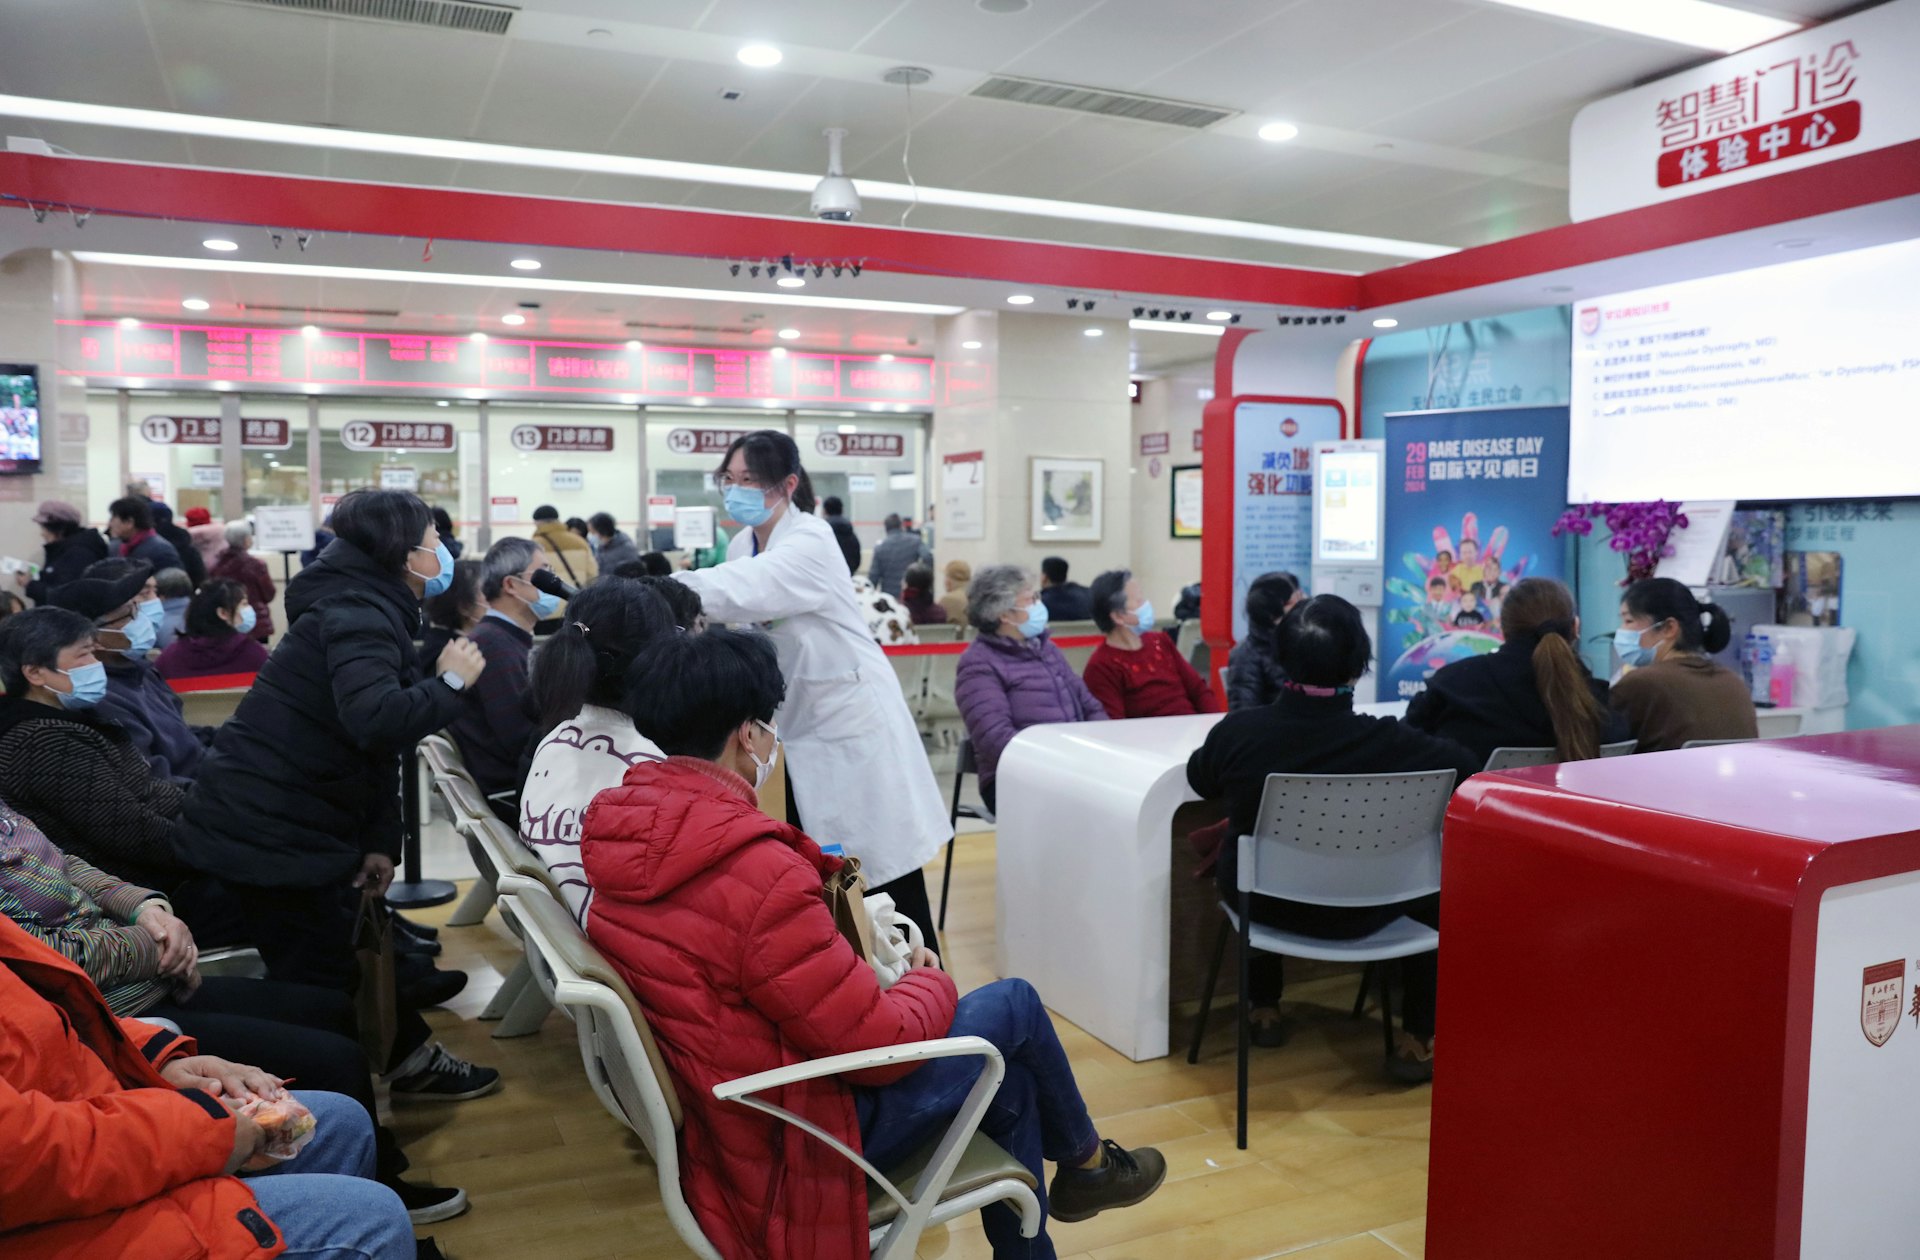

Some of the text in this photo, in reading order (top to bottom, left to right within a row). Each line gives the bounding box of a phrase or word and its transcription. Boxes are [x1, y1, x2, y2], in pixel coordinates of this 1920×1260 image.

[1656, 39, 1860, 149] 智慧门诊
[1679, 113, 1837, 183] 体验中心
[149, 422, 168, 438] 11
[349, 427, 370, 442] 12
[517, 431, 536, 445] 13
[674, 434, 690, 448] 14
[822, 438, 837, 451] 15
[1428, 437, 1544, 459] RARE DISEASE DAY
[1406, 442, 1427, 464] 29
[1405, 464, 1426, 479] FEB
[1428, 458, 1538, 480] 国际罕见病日
